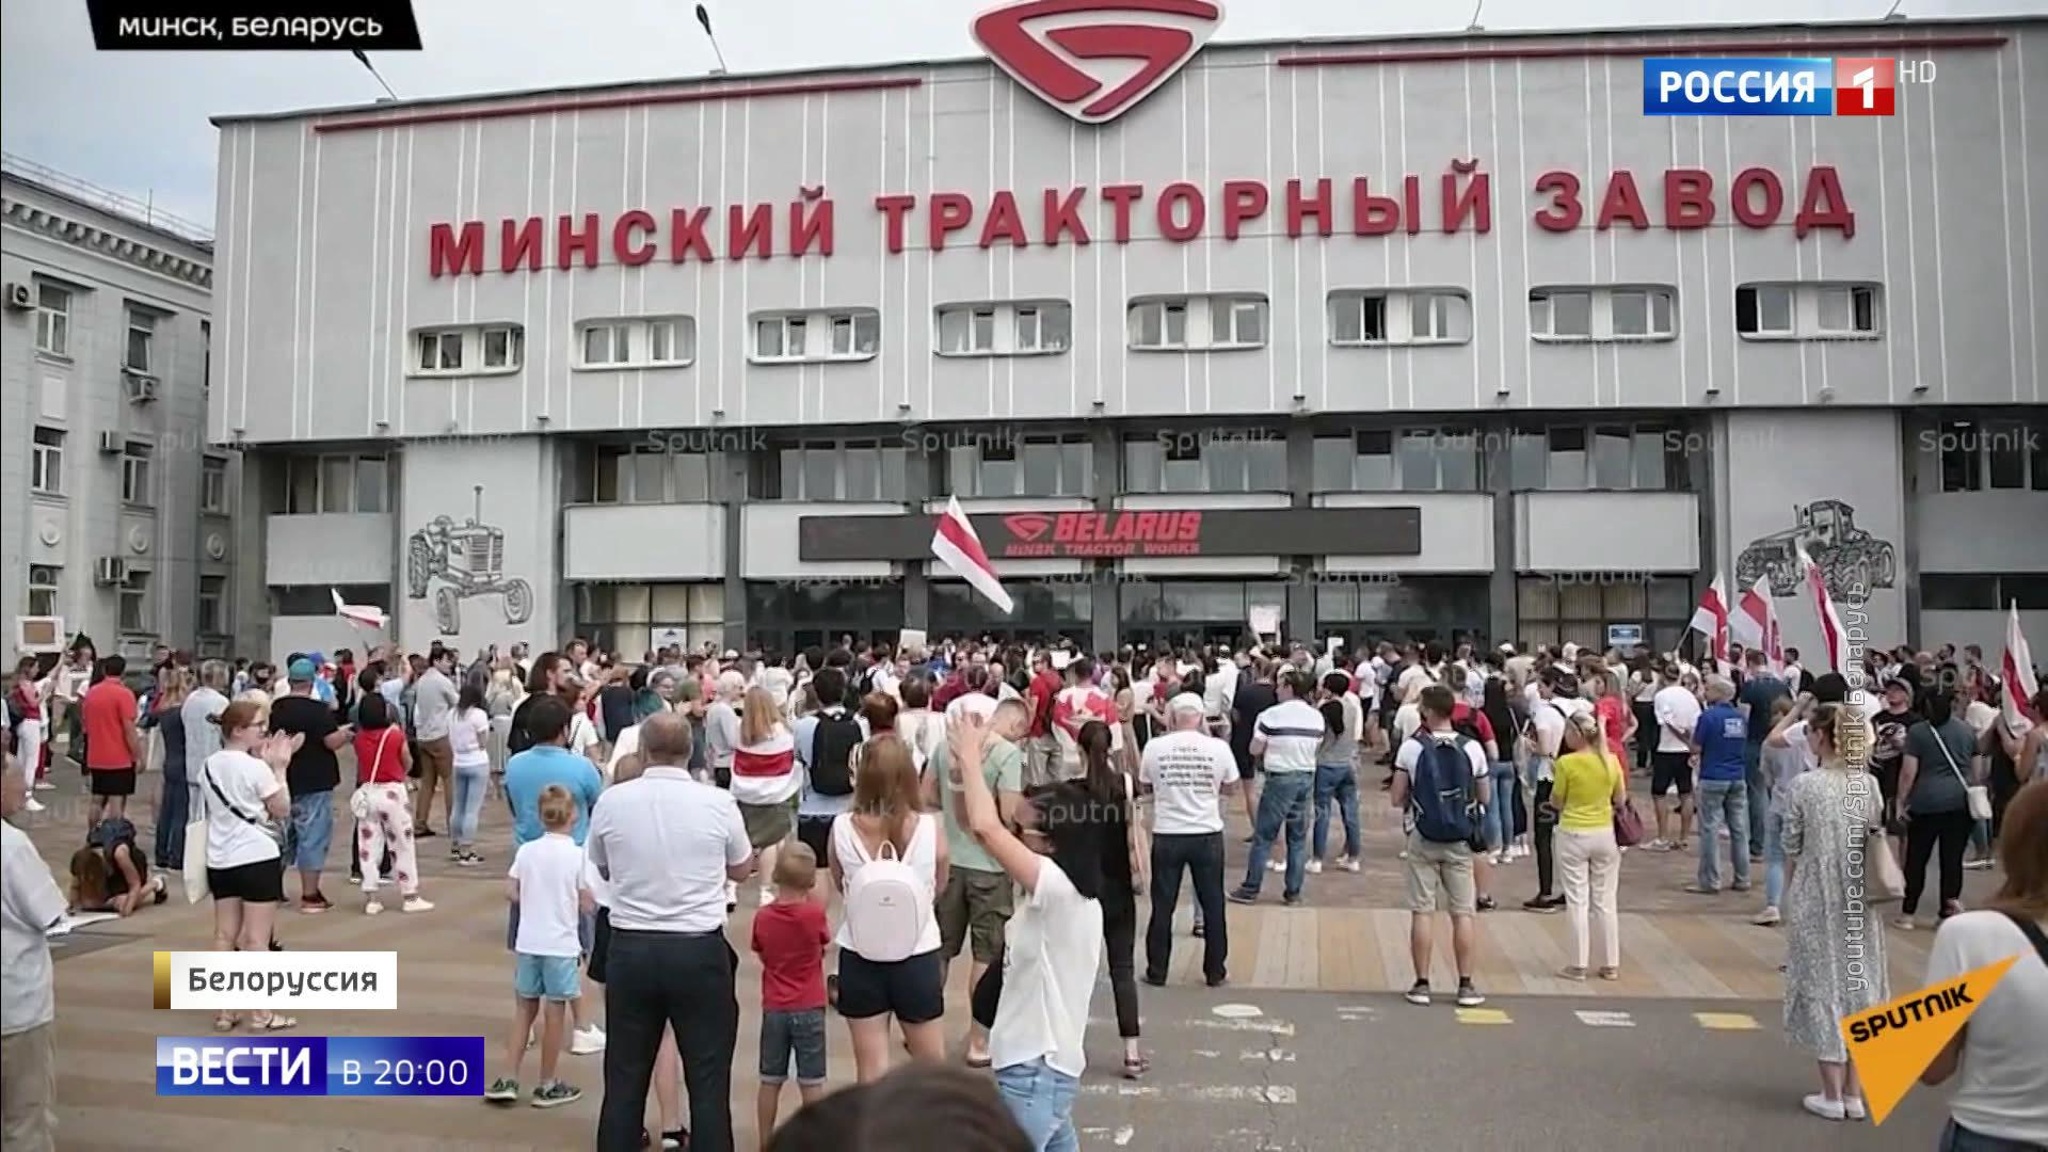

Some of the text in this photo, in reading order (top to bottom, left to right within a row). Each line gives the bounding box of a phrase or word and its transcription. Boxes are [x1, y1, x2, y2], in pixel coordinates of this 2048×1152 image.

[429, 158, 1856, 278] МИНСКИЙ ТРАКТОРНЫЙ ЗАВОД
[1054, 510, 1202, 541] BELARUS
[1005, 541, 1201, 556] MINSK TRACTOR WORKS
